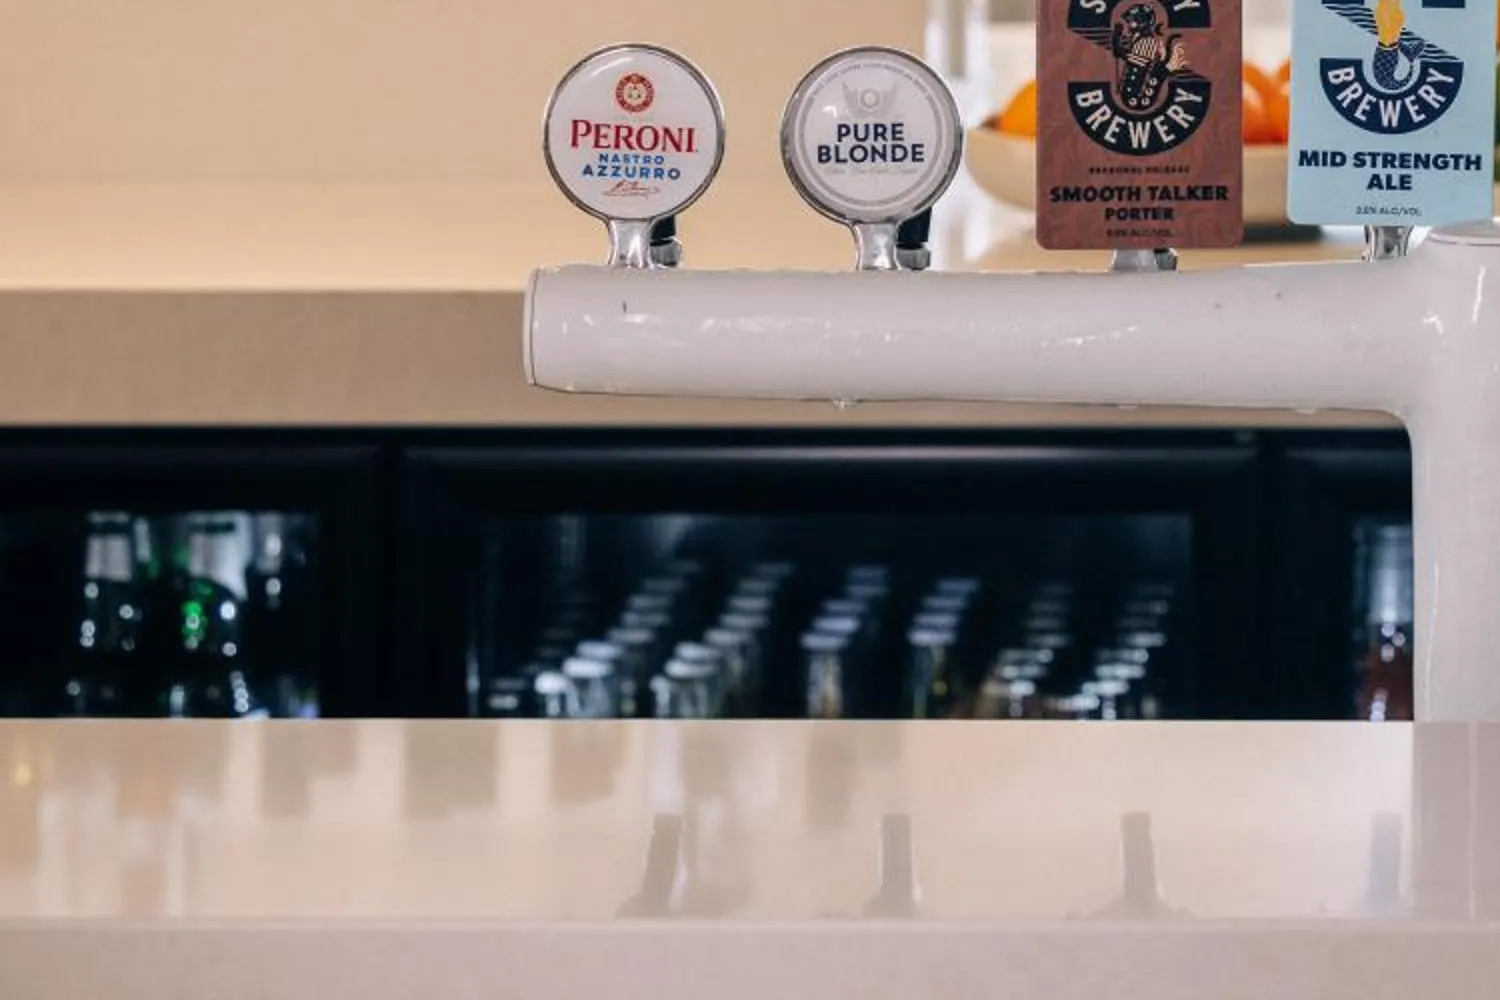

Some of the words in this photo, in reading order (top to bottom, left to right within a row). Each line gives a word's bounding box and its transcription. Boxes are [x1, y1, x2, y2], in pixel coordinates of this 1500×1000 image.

[1327, 65, 1456, 128] BREWERY
[1075, 87, 1203, 150] BREWERY
[570, 119, 696, 153] PERONI
[837, 122, 905, 142] PURE
[599, 153, 665, 165] NASTRO
[817, 143, 925, 163] BLONDE
[1298, 150, 1347, 168] MID
[1353, 151, 1482, 171] STRENGTH
[582, 164, 681, 180] AZZURRO
[1366, 173, 1413, 191] ALE
[1049, 186, 1141, 203] SMOOTH
[1146, 185, 1229, 201] TALKER
[1104, 207, 1175, 221] PORTER
